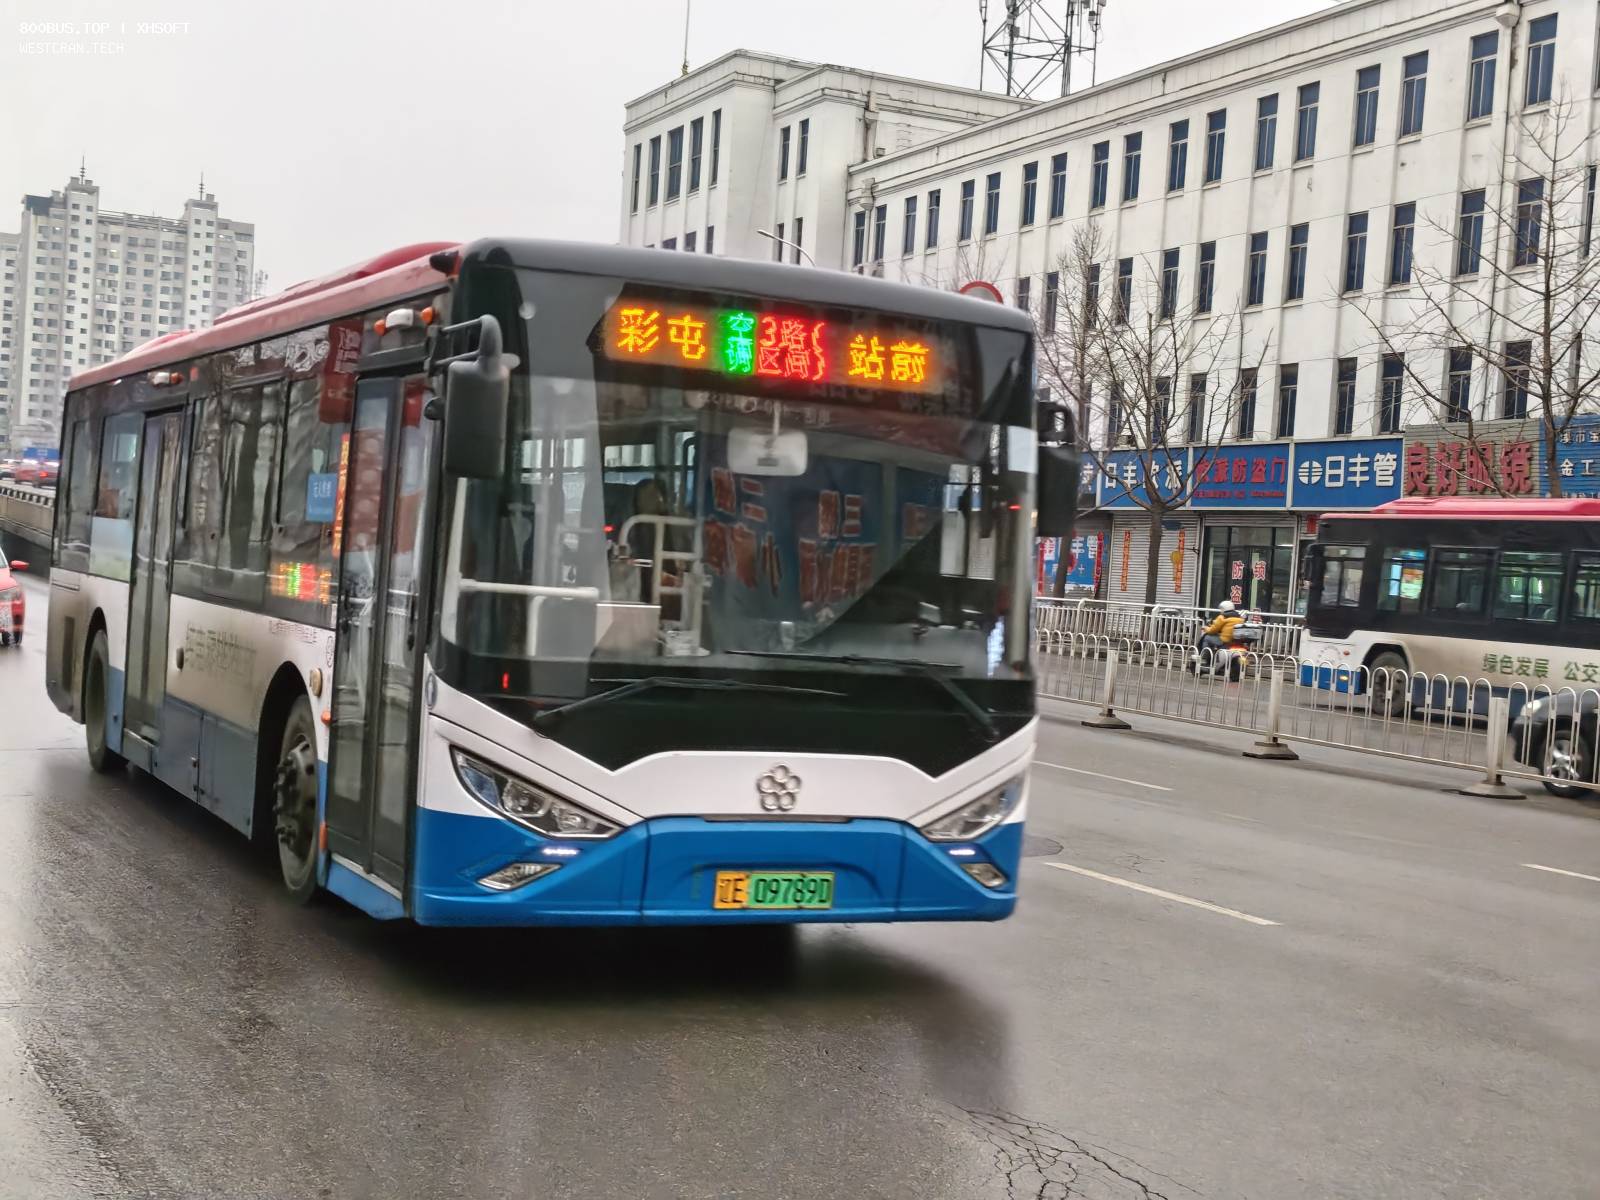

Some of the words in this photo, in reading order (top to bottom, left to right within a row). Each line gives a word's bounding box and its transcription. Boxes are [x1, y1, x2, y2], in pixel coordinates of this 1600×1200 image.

[617, 308, 706, 361] 彩屯
[726, 311, 755, 374] 空调
[849, 334, 930, 384] 站前
[1324, 452, 1398, 488] 日丰管
[1404, 439, 1534, 496] 良好眼镜
[1482, 652, 1549, 679] 绿色发展
[1564, 659, 1600, 684] 公交
